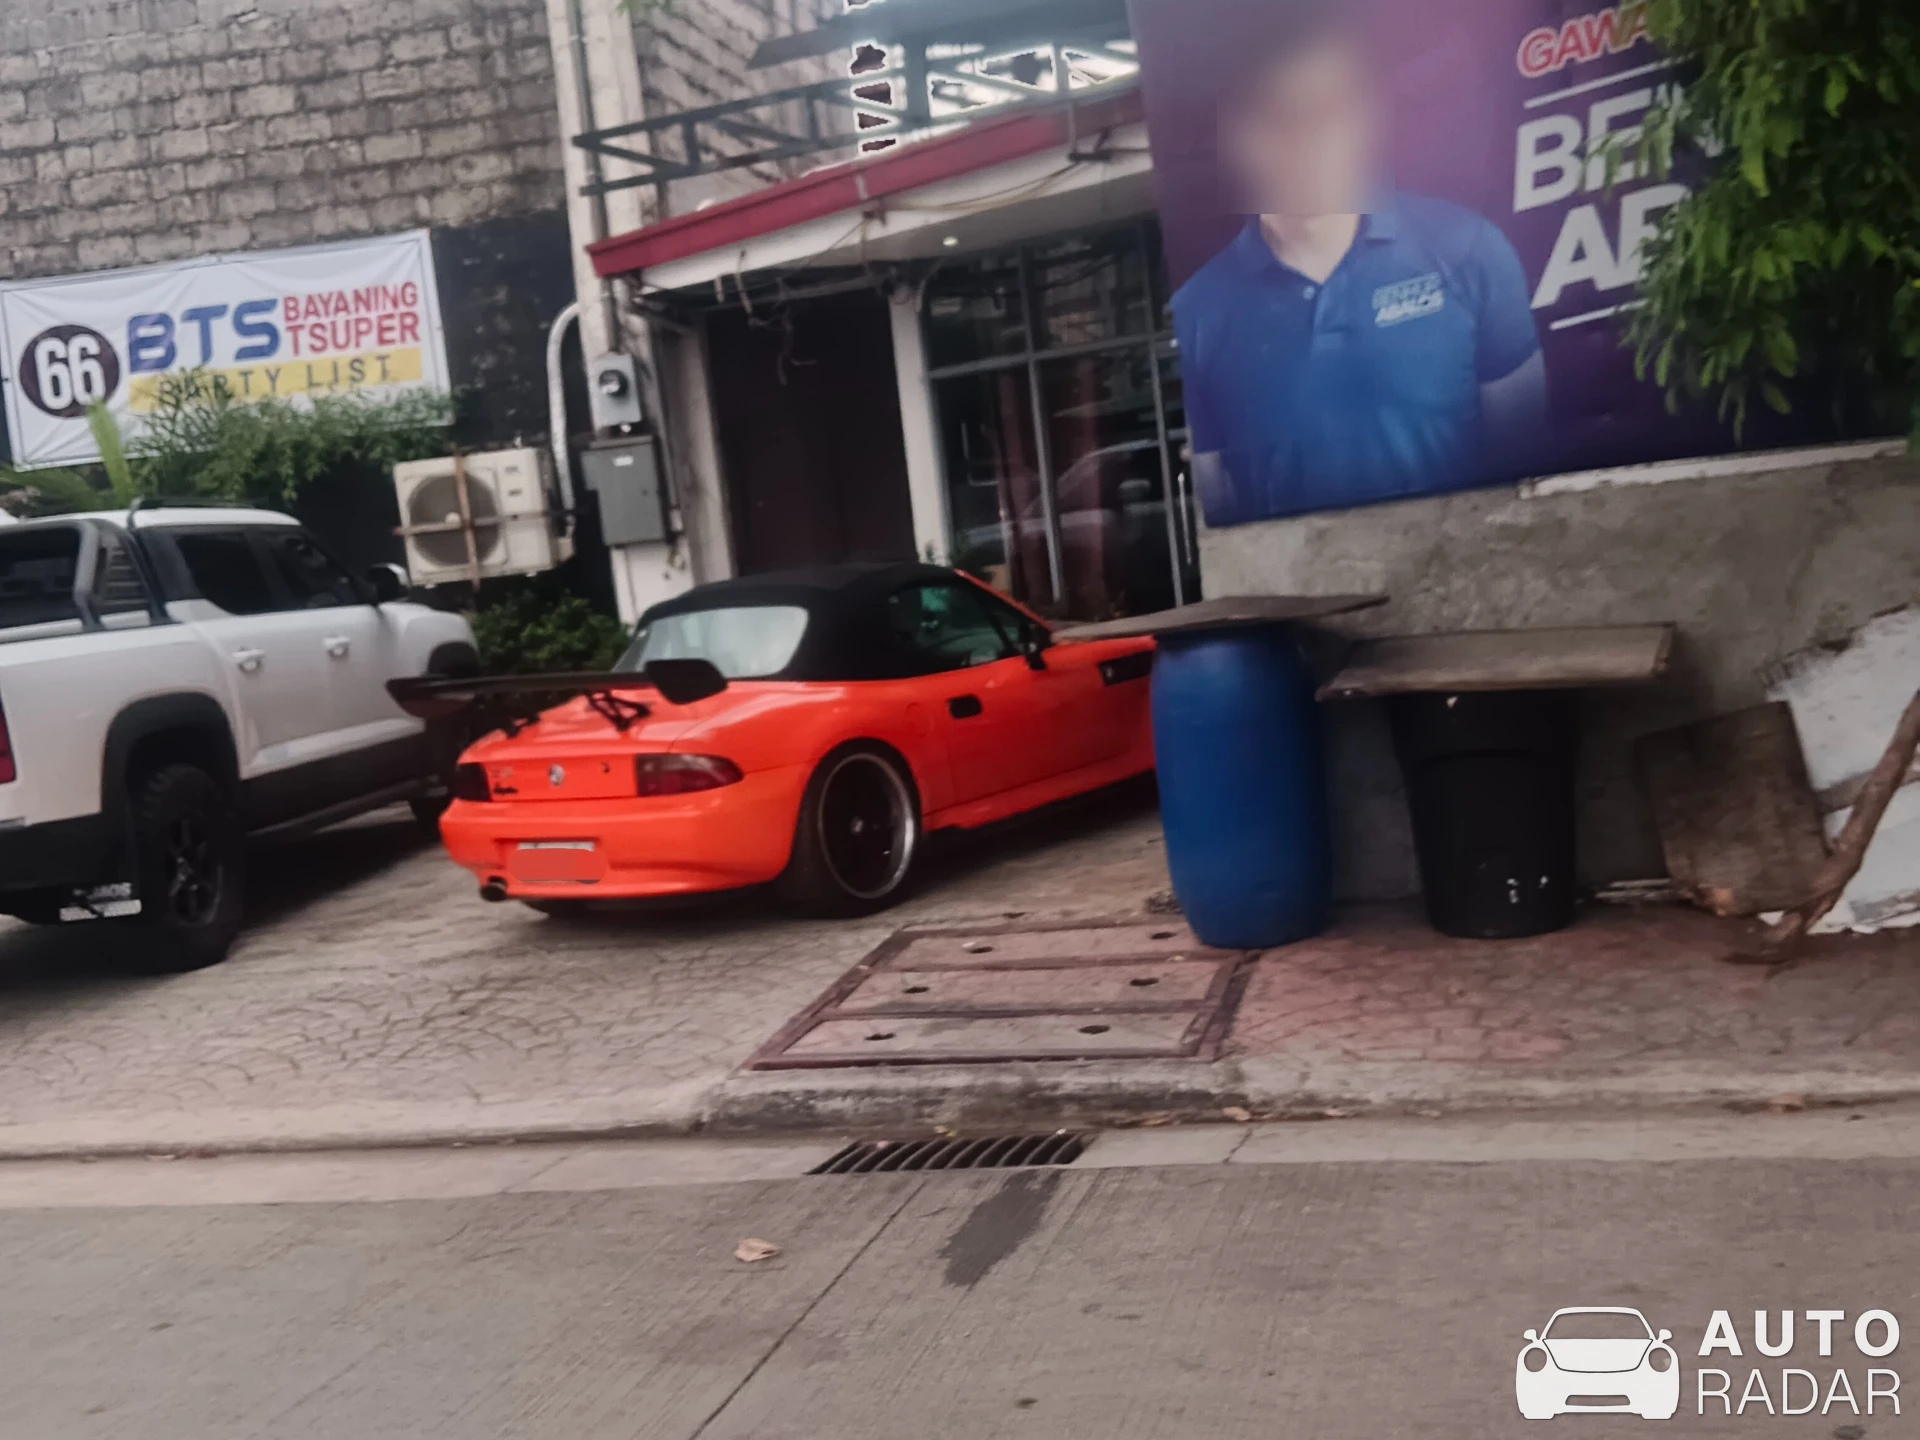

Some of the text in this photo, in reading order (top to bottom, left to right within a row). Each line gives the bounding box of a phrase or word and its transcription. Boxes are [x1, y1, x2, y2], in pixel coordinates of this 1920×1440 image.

[283, 281, 418, 321] BAYANING
[128, 299, 281, 375] BTS
[285, 311, 420, 357] TSUPER
[34, 333, 107, 411] 66
[306, 354, 391, 389] LIST
